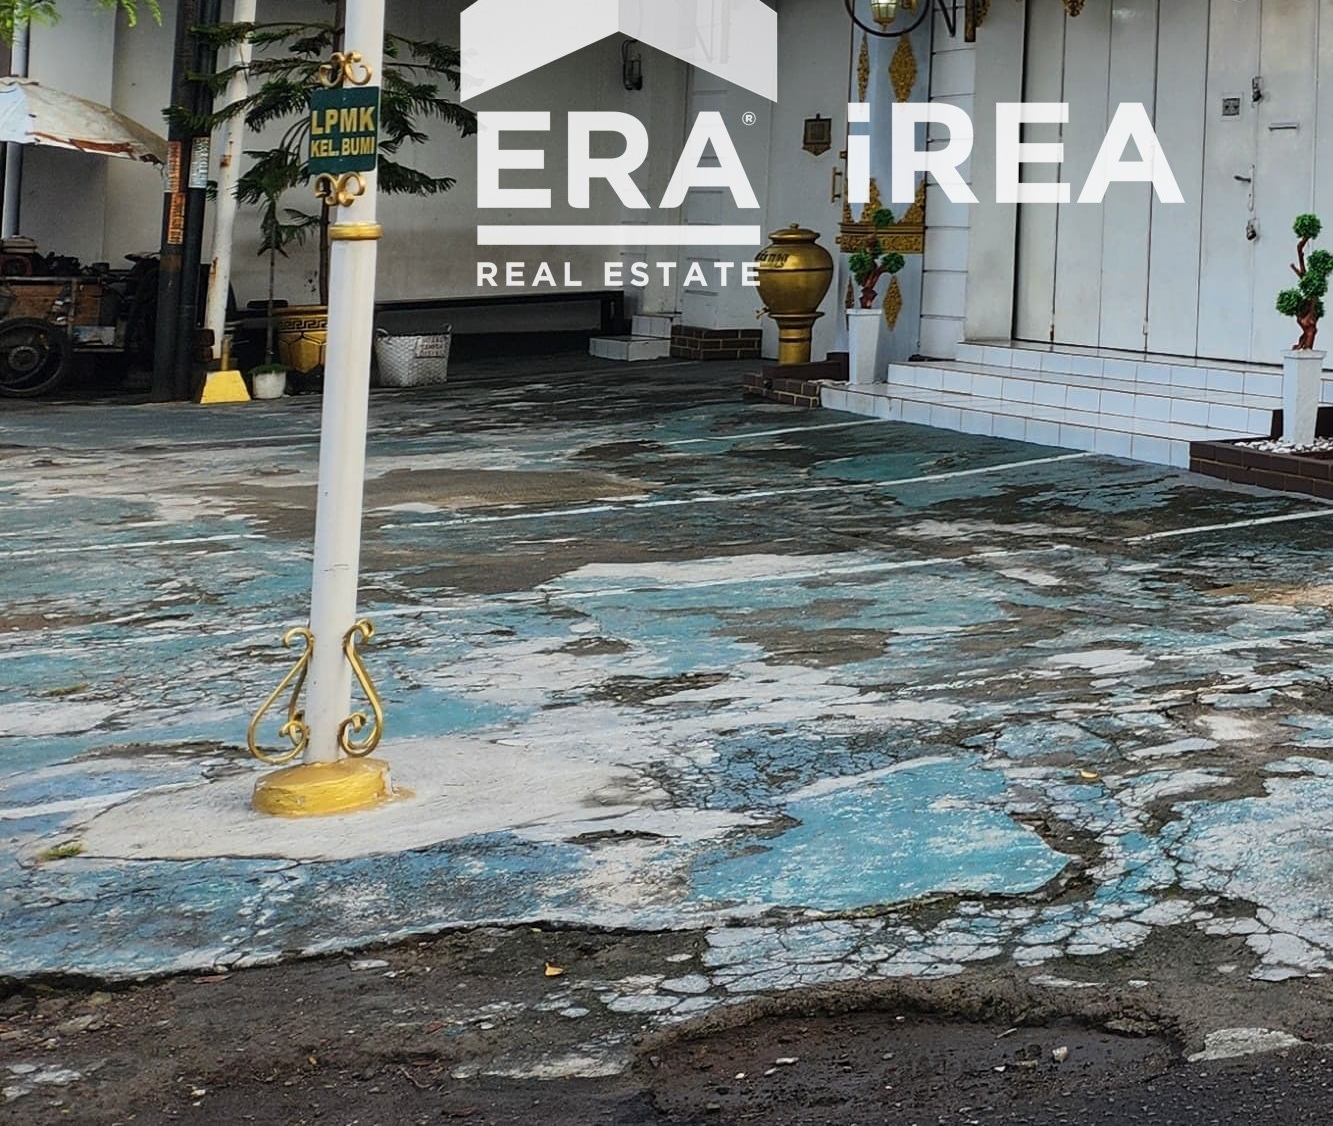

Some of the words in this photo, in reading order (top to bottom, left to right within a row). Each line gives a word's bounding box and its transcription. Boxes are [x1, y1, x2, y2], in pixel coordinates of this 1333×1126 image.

[311, 106, 376, 135] LPMK
[310, 139, 340, 158] KEL.
[341, 136, 375, 156] BUMI
